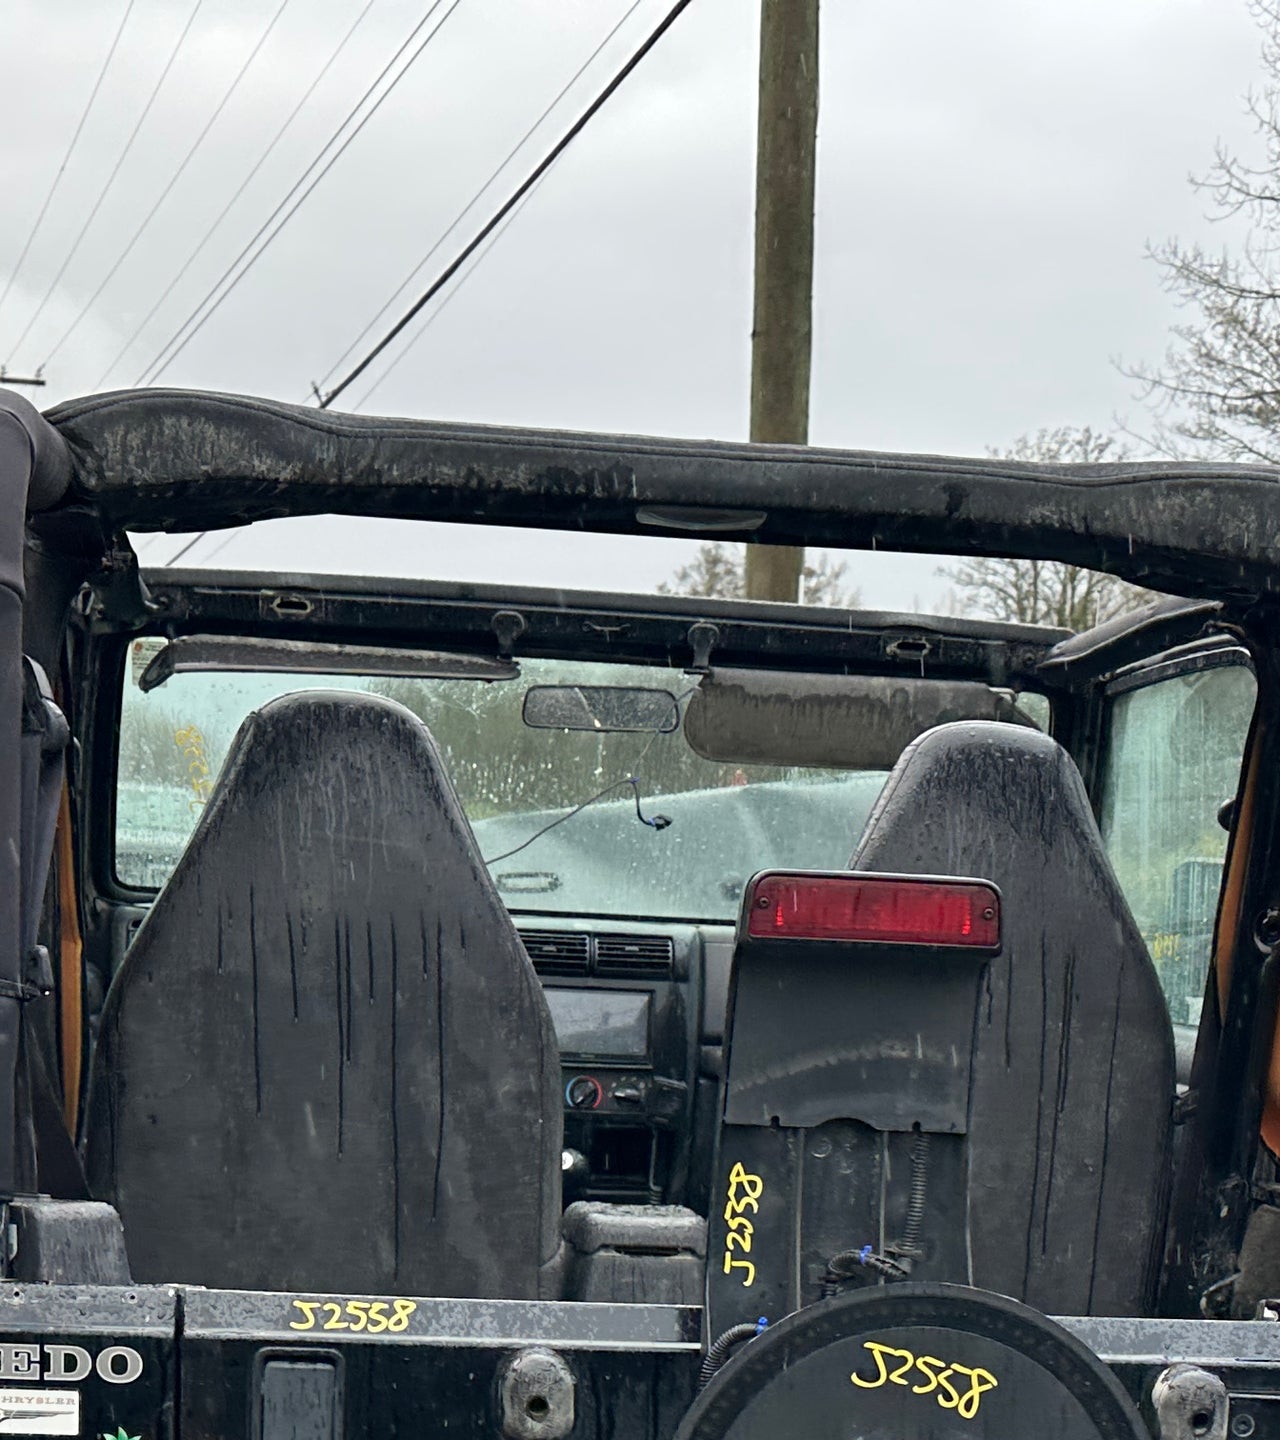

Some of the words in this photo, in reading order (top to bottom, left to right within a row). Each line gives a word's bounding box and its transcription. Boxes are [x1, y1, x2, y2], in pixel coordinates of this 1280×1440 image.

[723, 1160, 764, 1287] J2558
[289, 1299, 417, 1333] J2558
[851, 1341, 999, 1420] J2558
